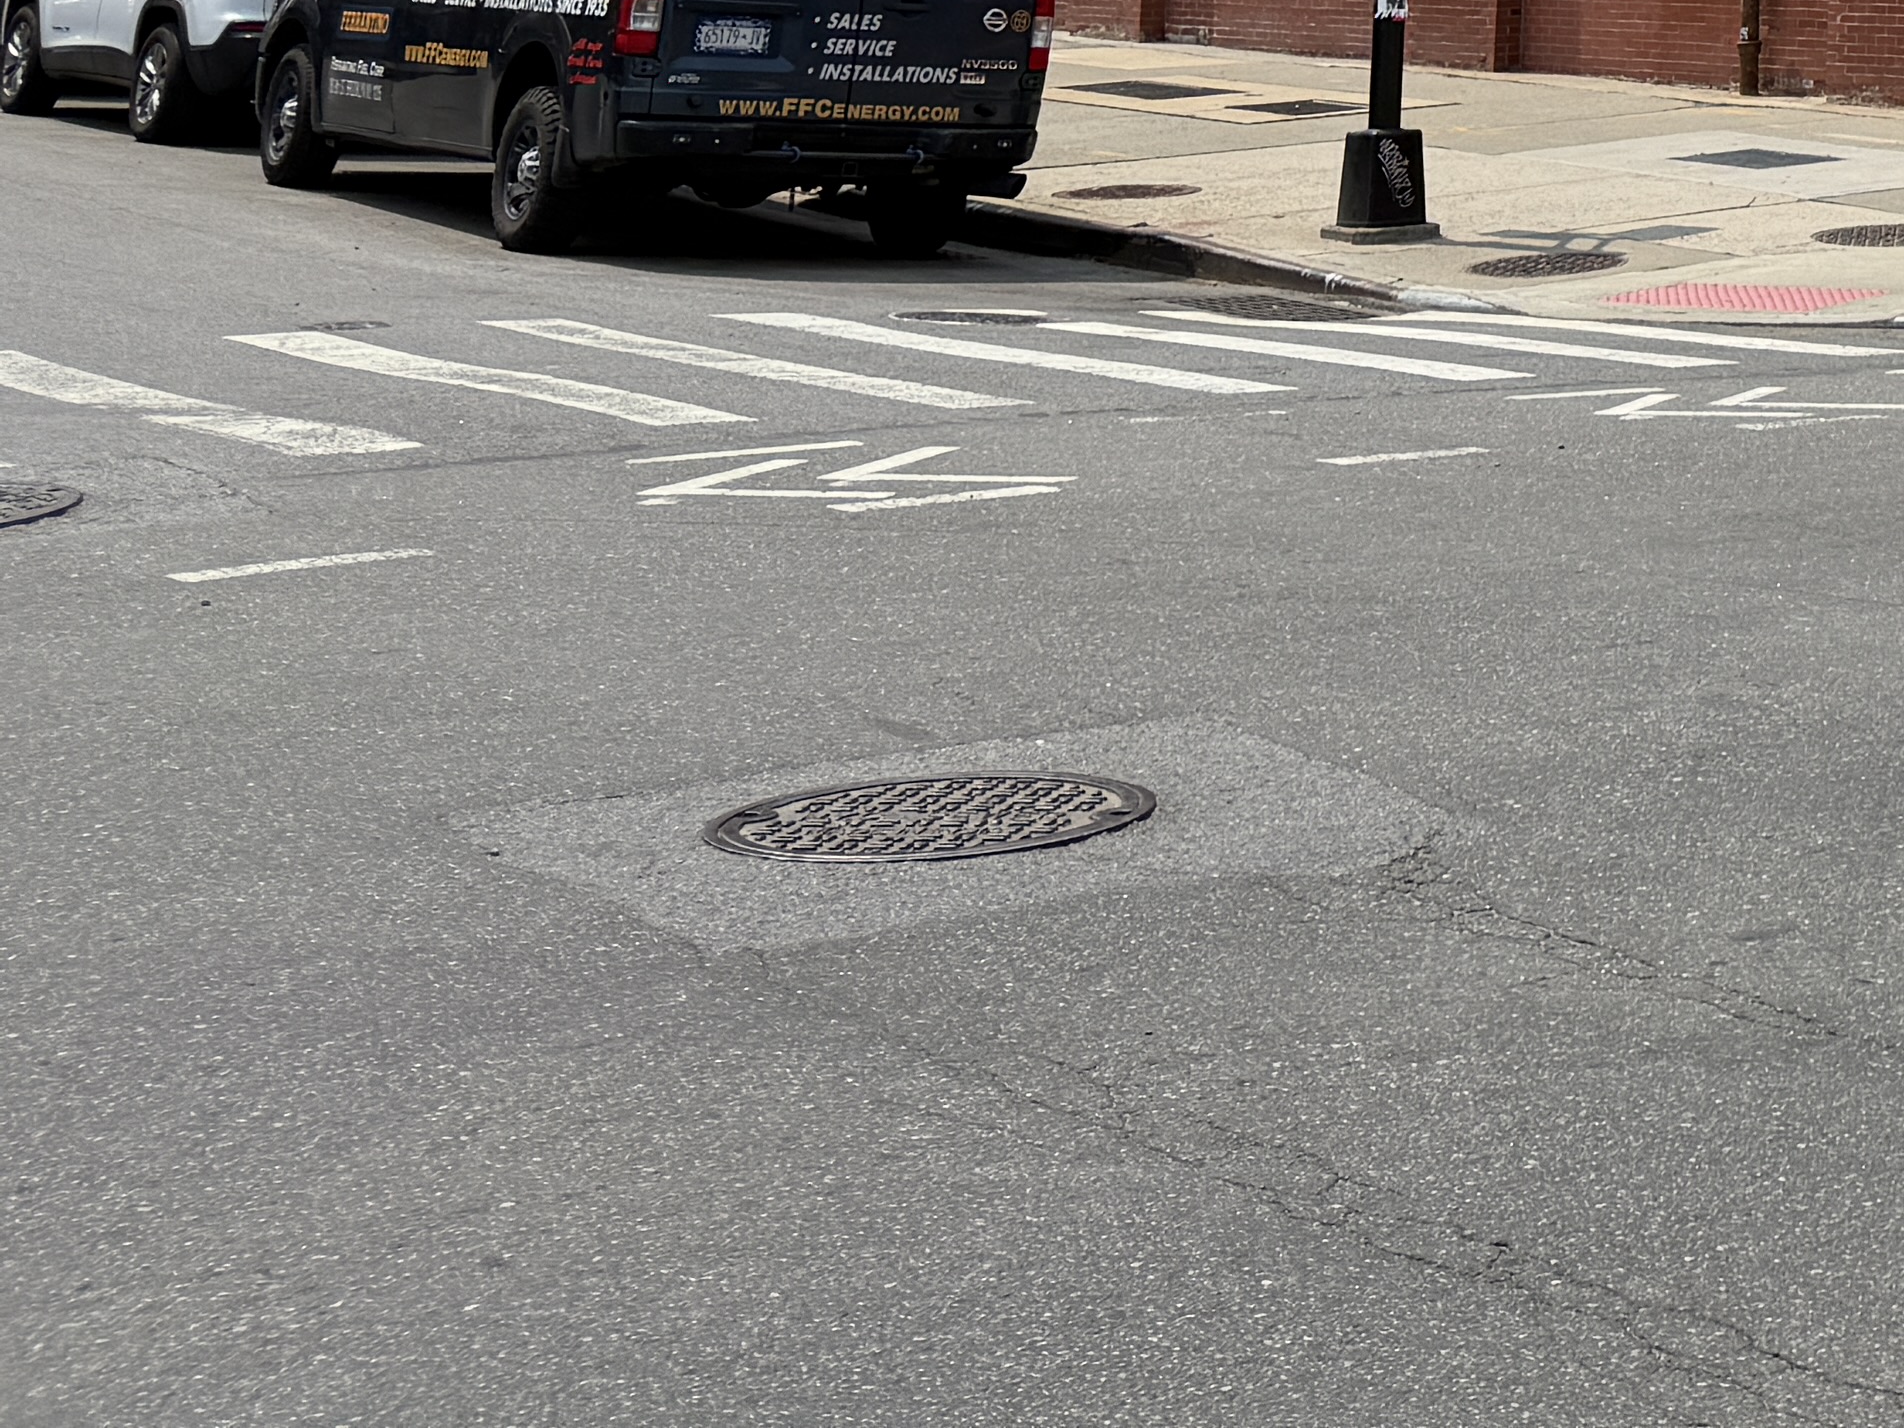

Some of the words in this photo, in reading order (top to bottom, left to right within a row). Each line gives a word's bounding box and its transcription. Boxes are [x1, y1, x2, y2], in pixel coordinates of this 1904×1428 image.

[340, 11, 390, 34] FERRANTINO
[826, 12, 883, 32] SALES
[823, 38, 896, 57] SERVICE
[819, 63, 958, 84] INSTALLATIONS
